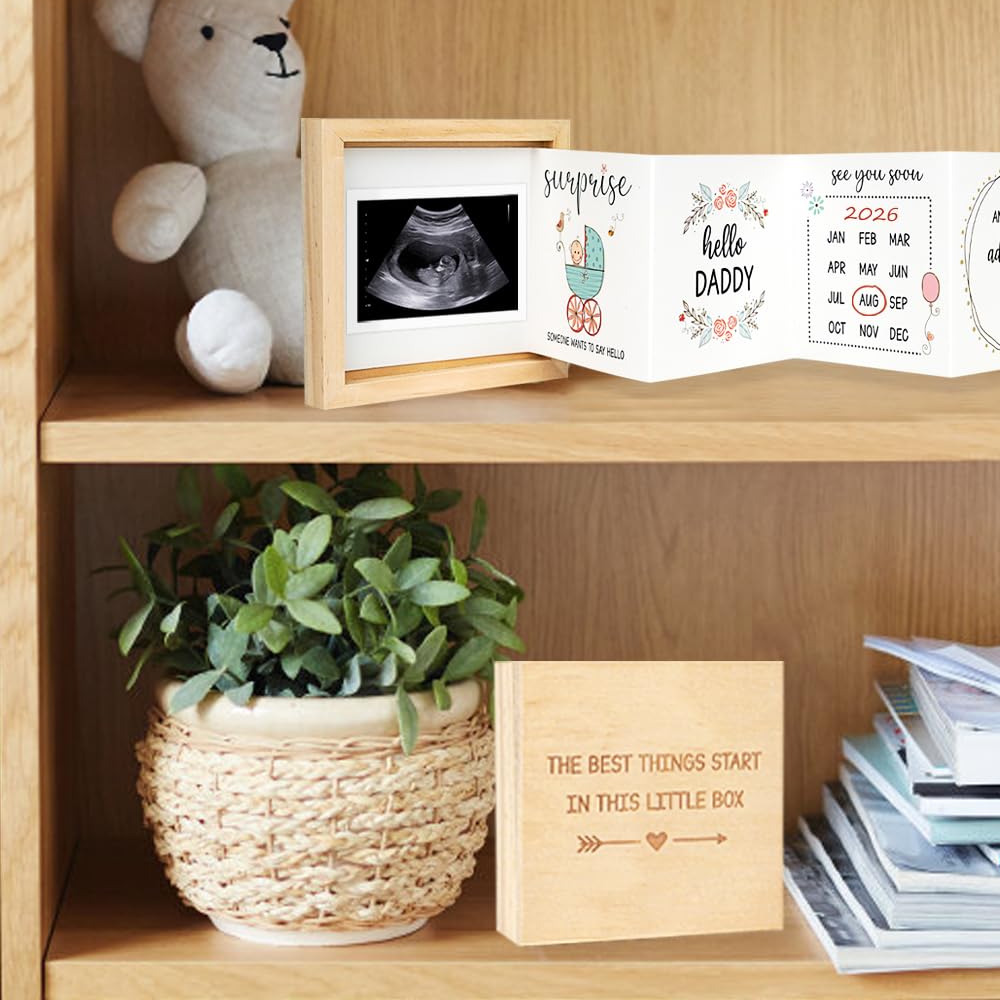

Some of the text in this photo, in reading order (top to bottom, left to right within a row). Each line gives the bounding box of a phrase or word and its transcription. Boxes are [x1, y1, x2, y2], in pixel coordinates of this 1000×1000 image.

[831, 168, 923, 192] see you soon
[544, 169, 632, 215] surprise
[844, 206, 899, 221] 2026
[702, 223, 747, 259] hello
[827, 231, 910, 246] JAN FEB MAR
[827, 261, 908, 278] APR MAY JUN
[695, 265, 754, 298] DADDY
[828, 291, 908, 309] JUL AUG SEP
[828, 321, 909, 341] OCT NOV DEC
[547, 332, 625, 360] SOMEONE WANTS TO SAY HELLO
[547, 752, 762, 775] THE BEST THINGS START
[566, 790, 745, 814] IN THIS LITTLE BOX
